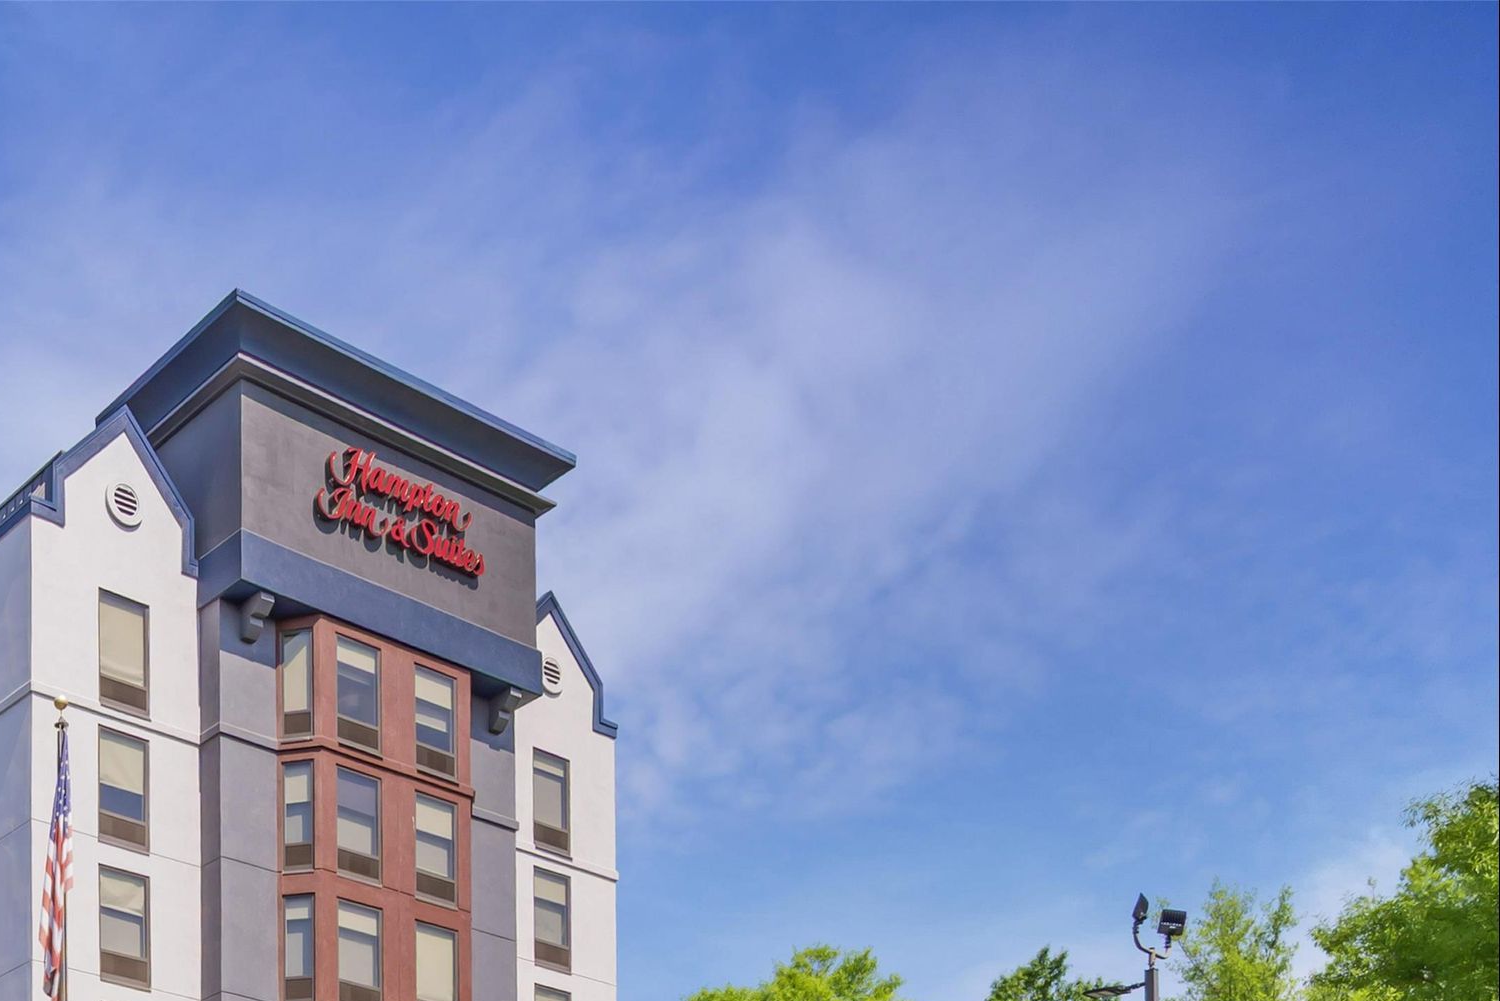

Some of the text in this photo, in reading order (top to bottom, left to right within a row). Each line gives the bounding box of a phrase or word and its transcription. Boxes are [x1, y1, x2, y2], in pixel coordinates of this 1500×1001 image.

[317, 488, 485, 576] Inn & Suites
[329, 447, 472, 531] Hampton
